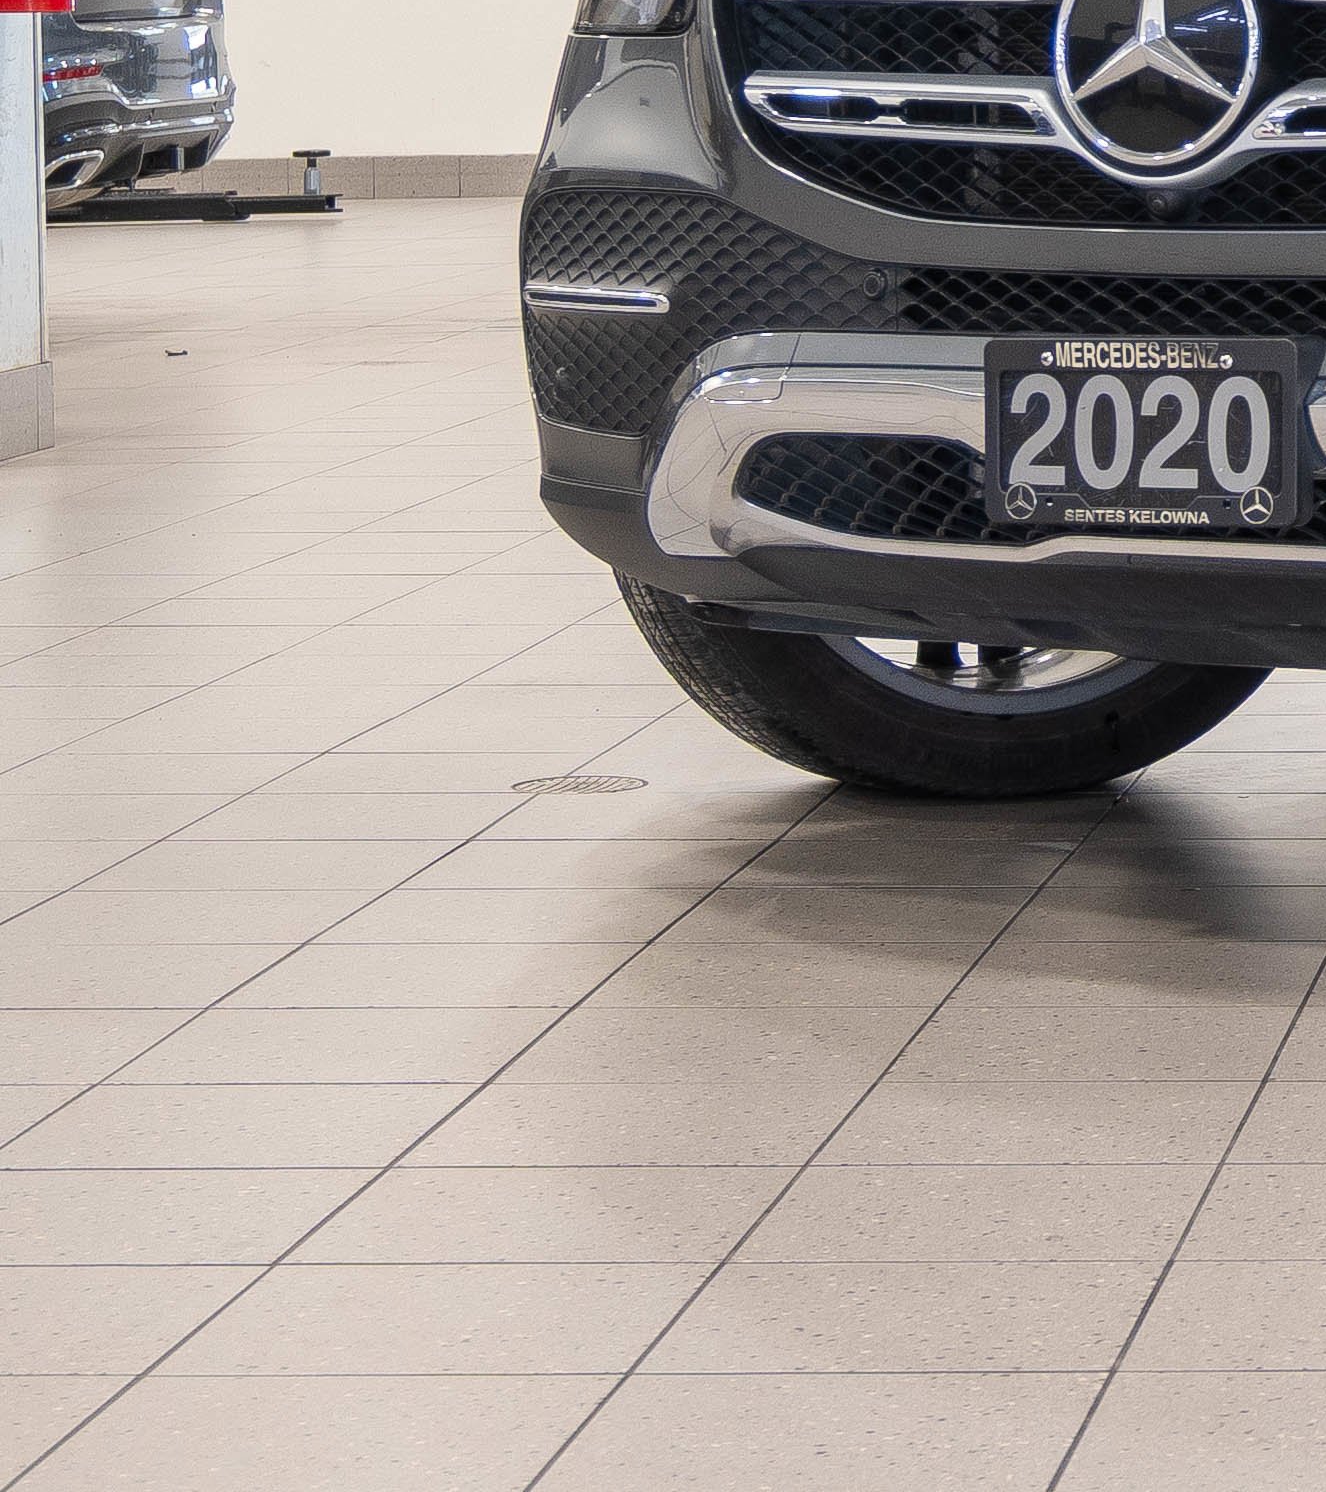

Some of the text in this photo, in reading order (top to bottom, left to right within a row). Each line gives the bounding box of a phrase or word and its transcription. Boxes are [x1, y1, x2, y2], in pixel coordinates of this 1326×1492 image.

[1055, 341, 1219, 368] MERCEDES-BENZ
[1008, 373, 1271, 493] 2020
[1064, 509, 1210, 524] SENTES KELOWNA
